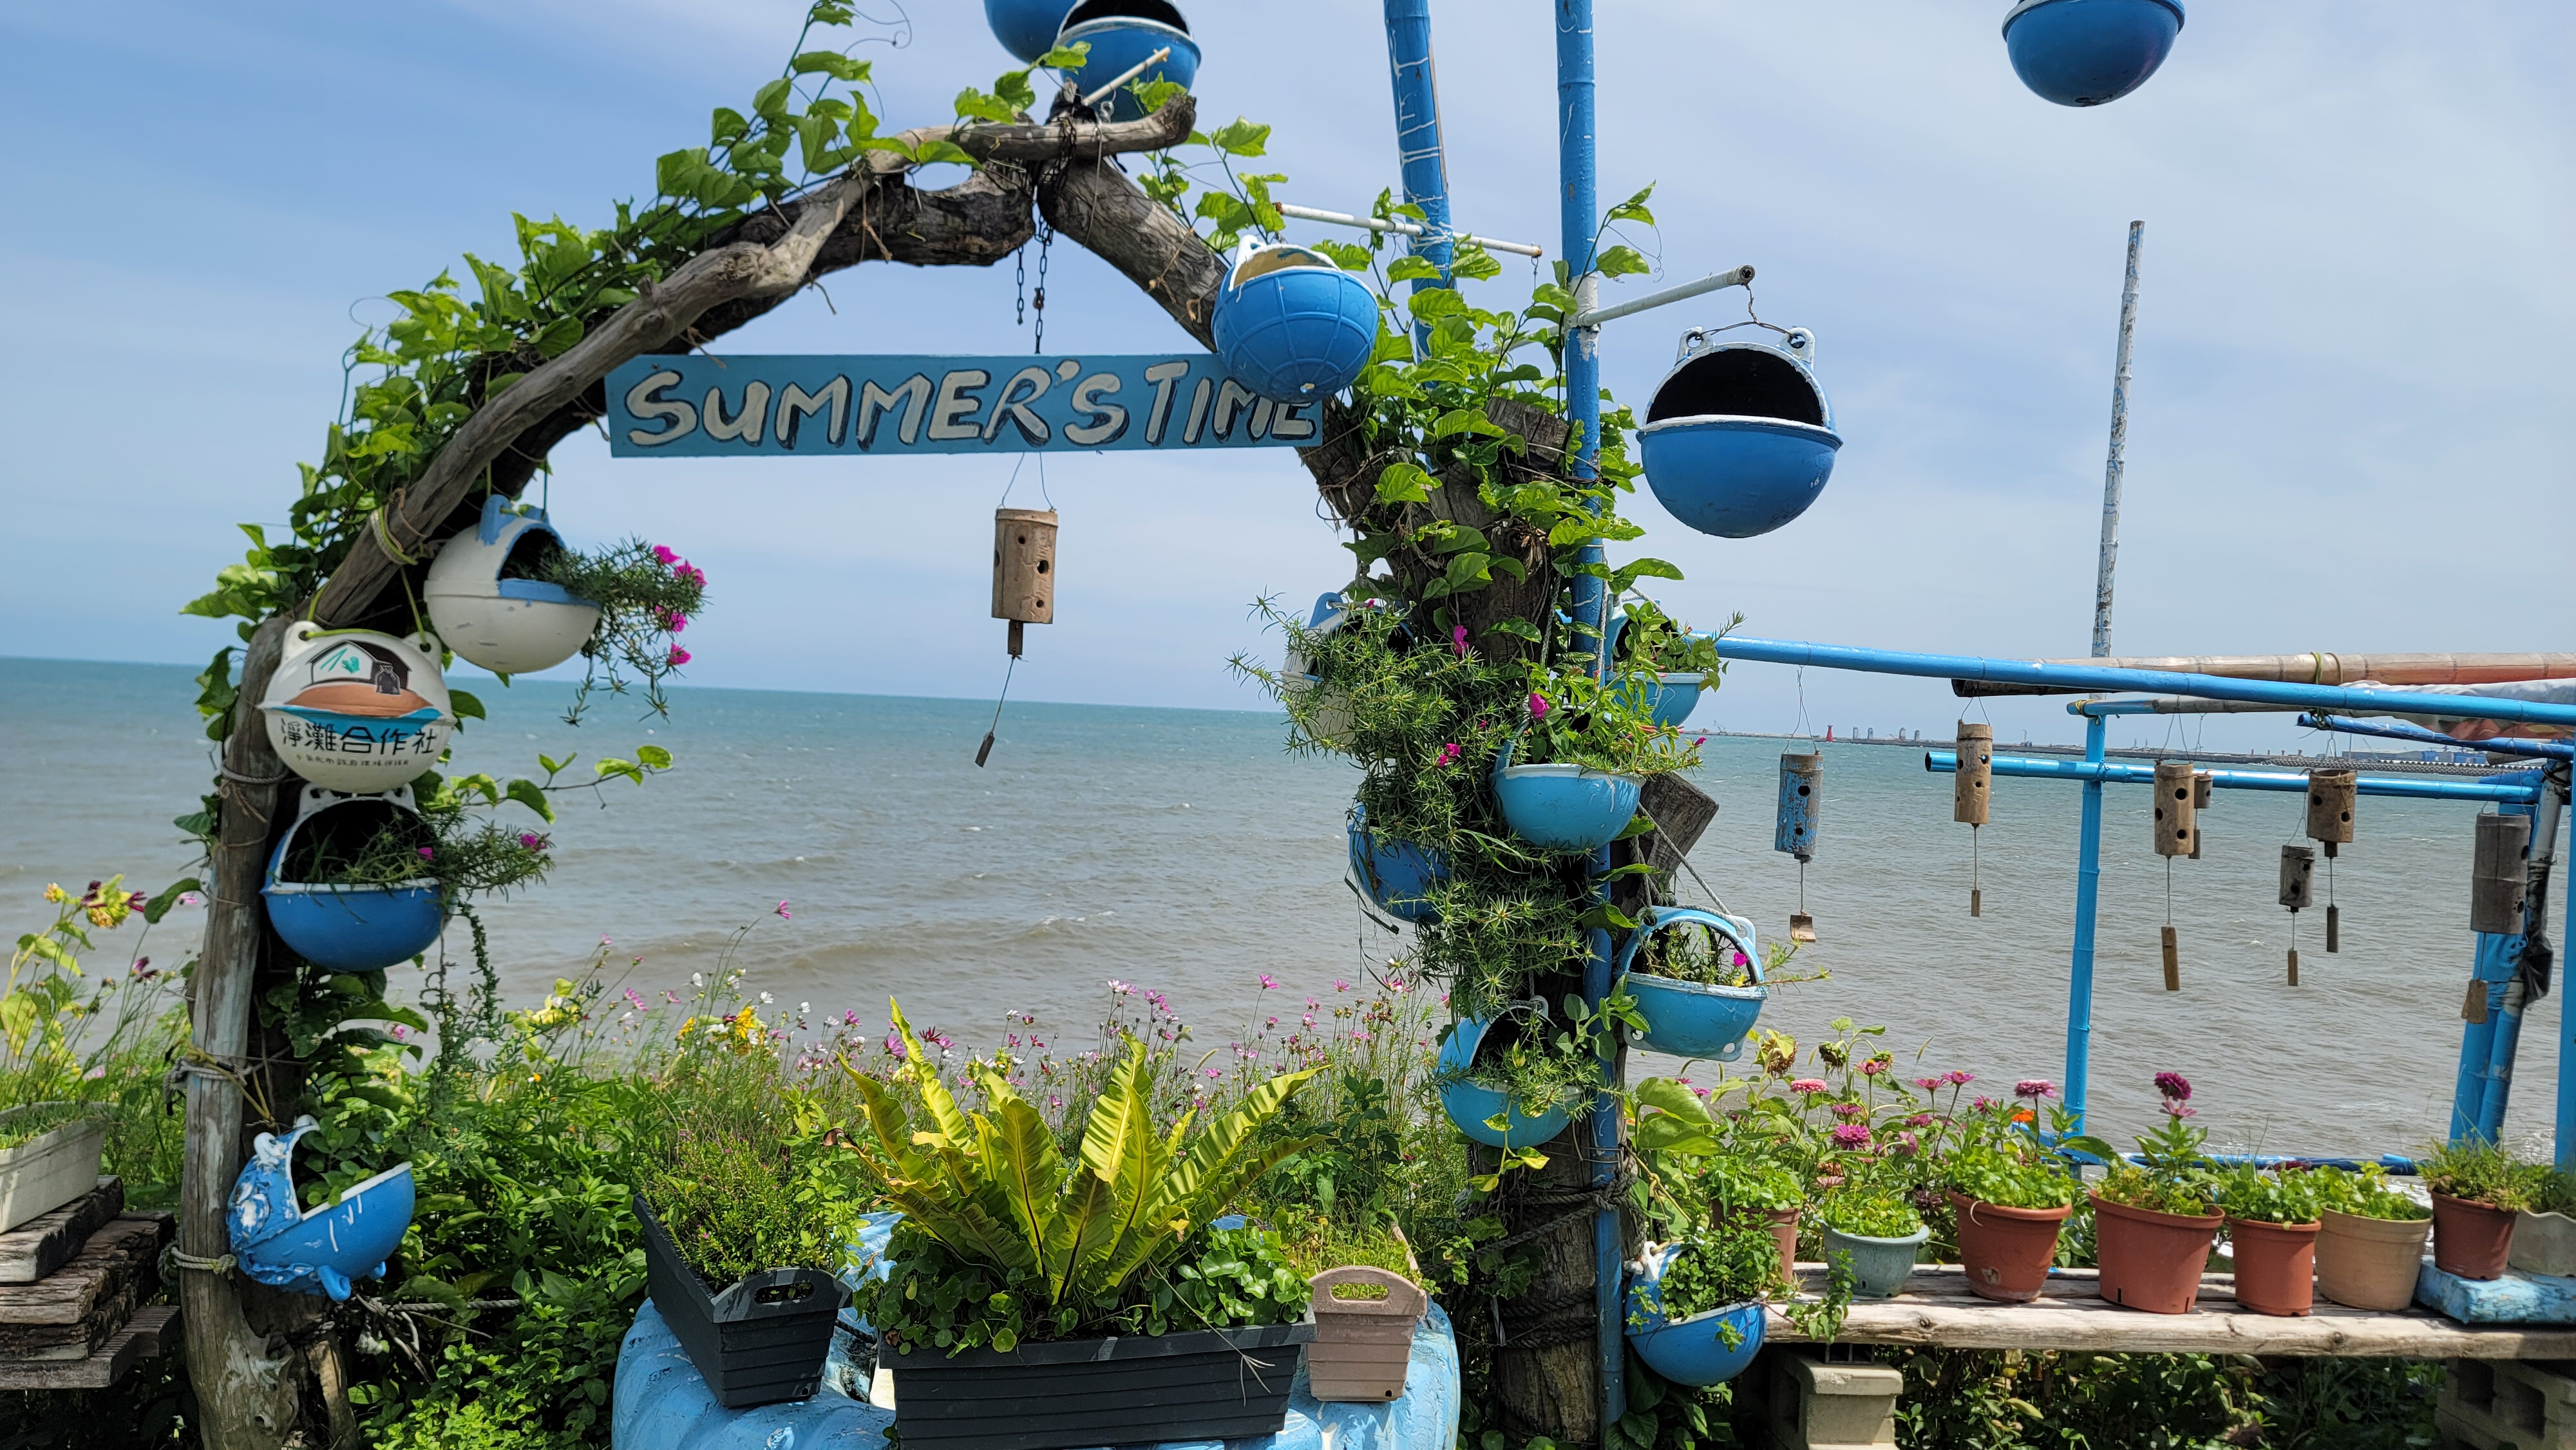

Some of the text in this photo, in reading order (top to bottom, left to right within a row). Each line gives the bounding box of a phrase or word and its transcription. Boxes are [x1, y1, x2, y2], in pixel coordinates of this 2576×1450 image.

[625, 359, 1130, 450] SUMMER'S
[280, 717, 438, 755] 淨灘合作社
